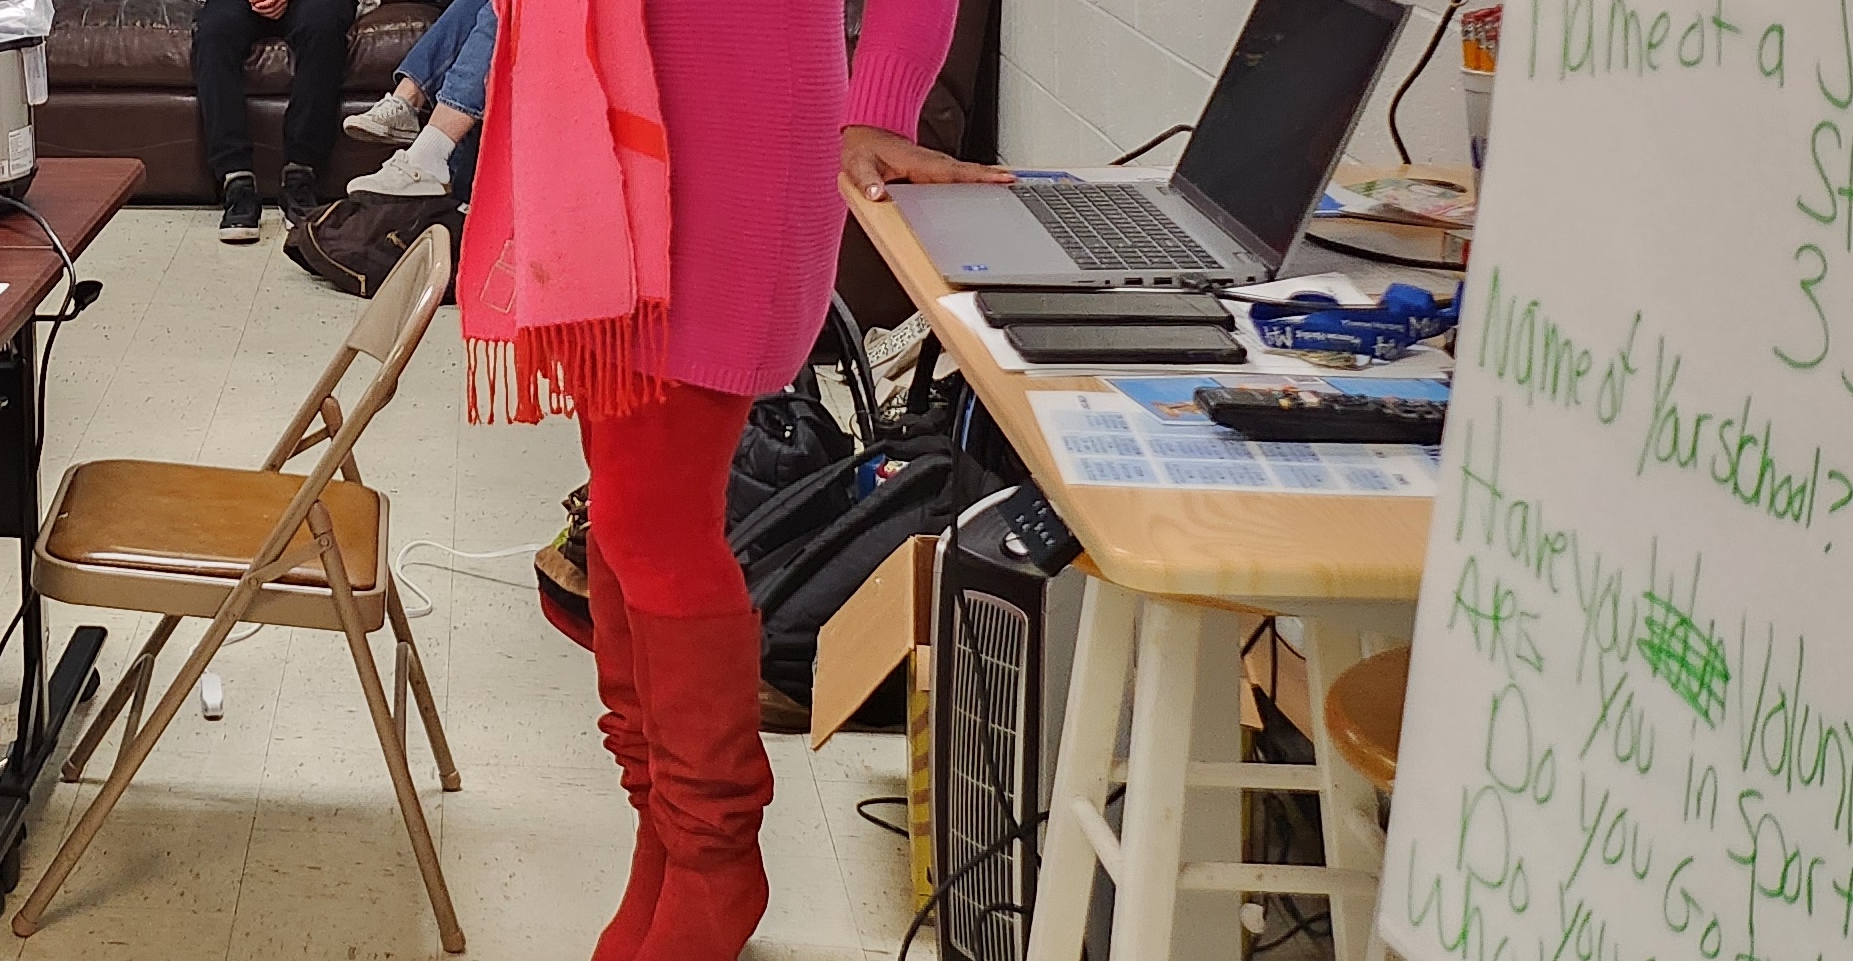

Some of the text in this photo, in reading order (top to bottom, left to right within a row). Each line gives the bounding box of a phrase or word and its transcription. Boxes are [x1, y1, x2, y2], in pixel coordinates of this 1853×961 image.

[1758, 23, 1785, 89] a
[1478, 265, 1593, 408] Name
[1455, 395, 1568, 595] Have
[1485, 682, 1557, 805] Do
